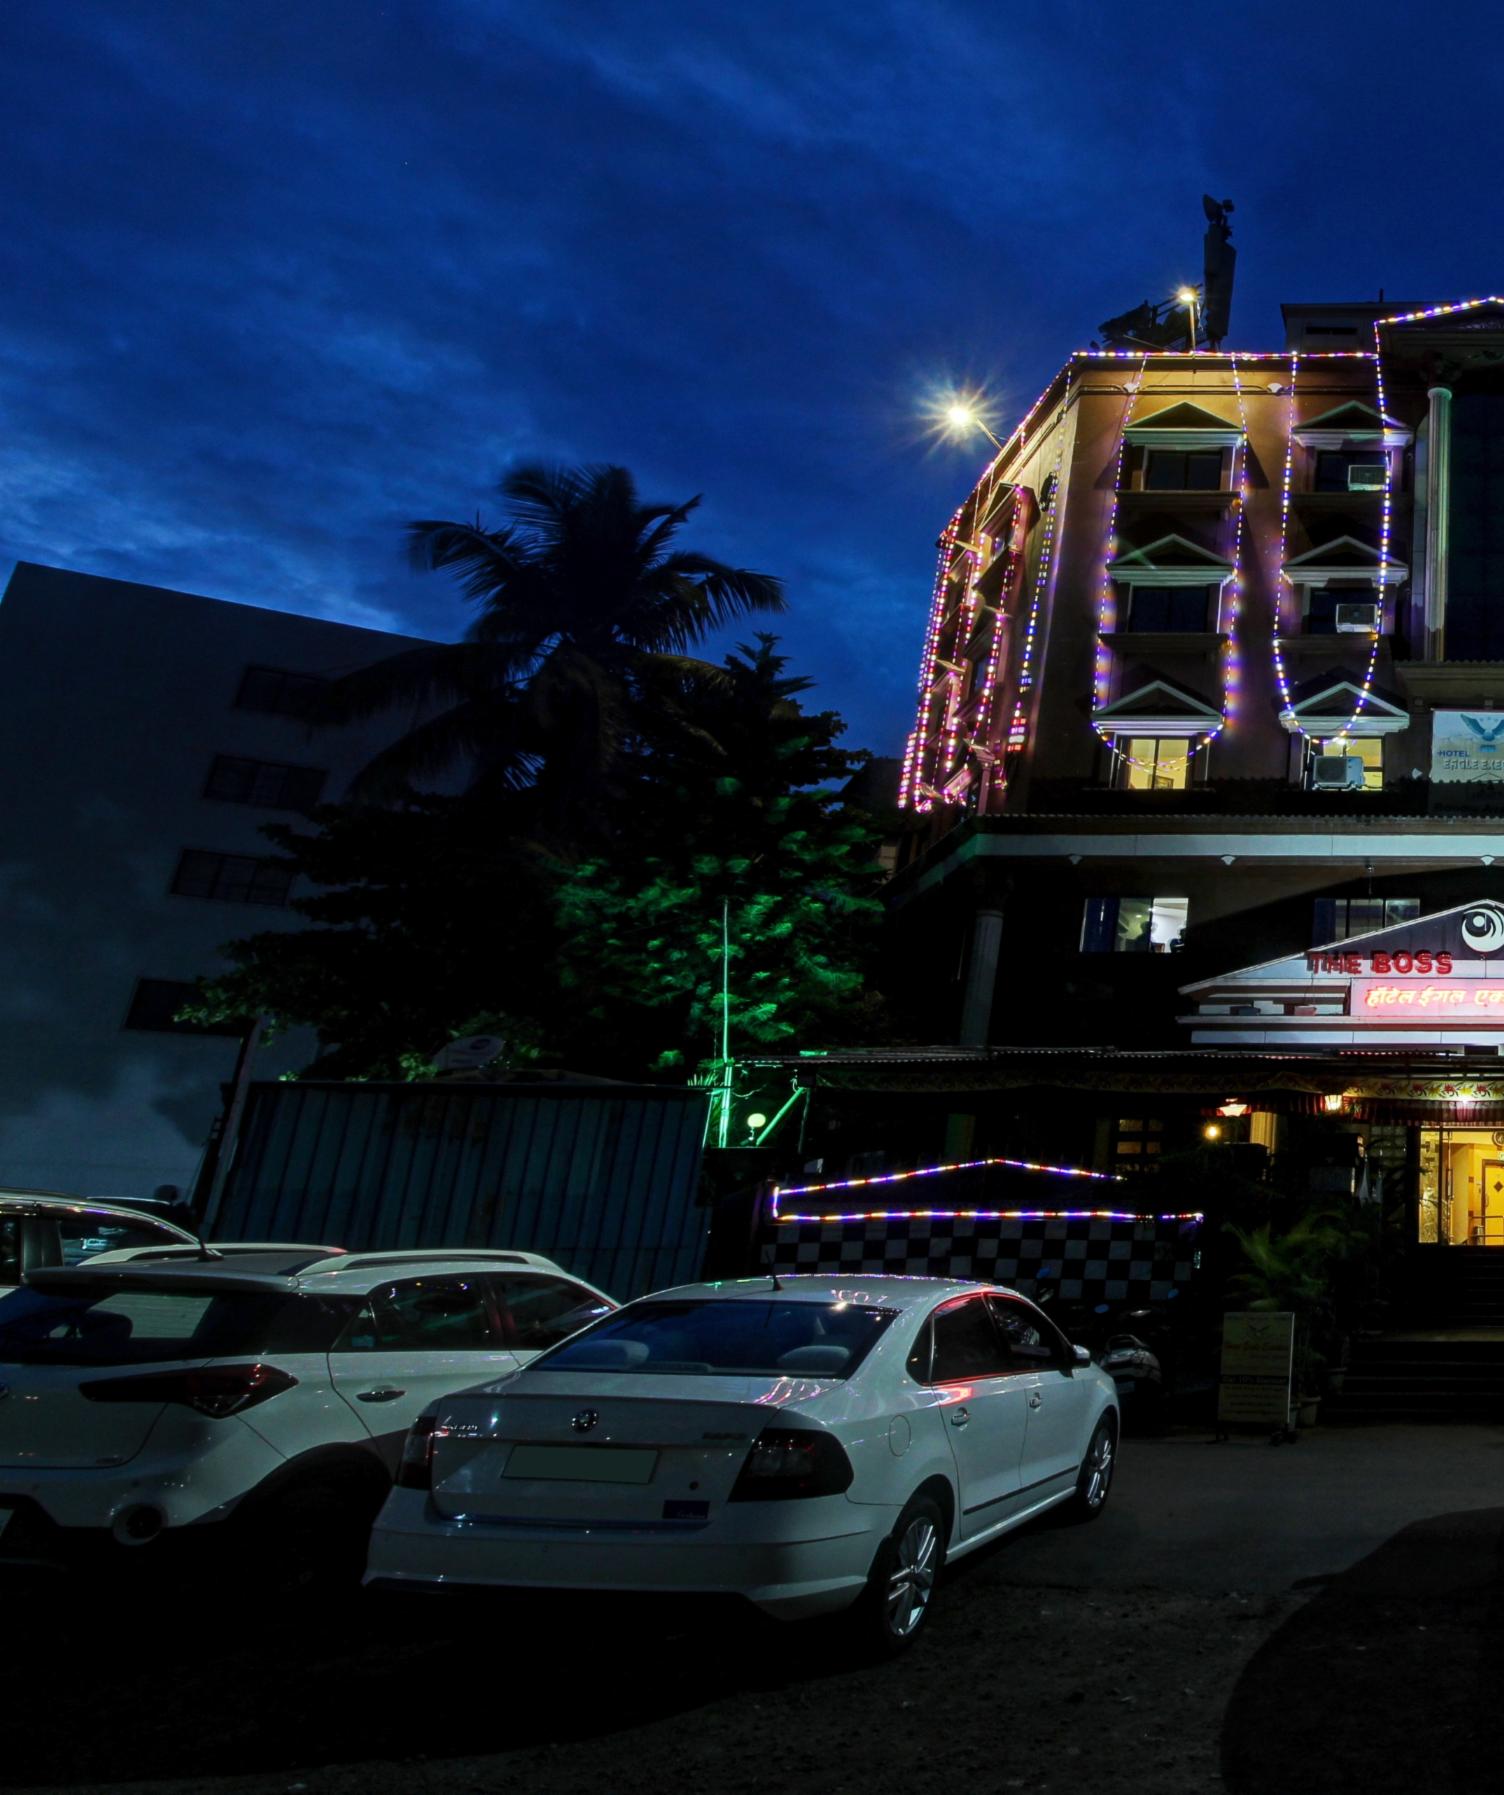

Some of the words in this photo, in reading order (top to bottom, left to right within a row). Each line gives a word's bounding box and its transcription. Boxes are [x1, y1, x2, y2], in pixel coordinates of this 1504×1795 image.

[1437, 750, 1470, 758] HOTEL
[1443, 759, 1478, 771] EAGLE
[1306, 950, 1363, 975] THE
[1371, 949, 1453, 975] BOSS
[1365, 985, 1416, 1008] हॉटेल
[1418, 985, 1467, 1007] ईगल
